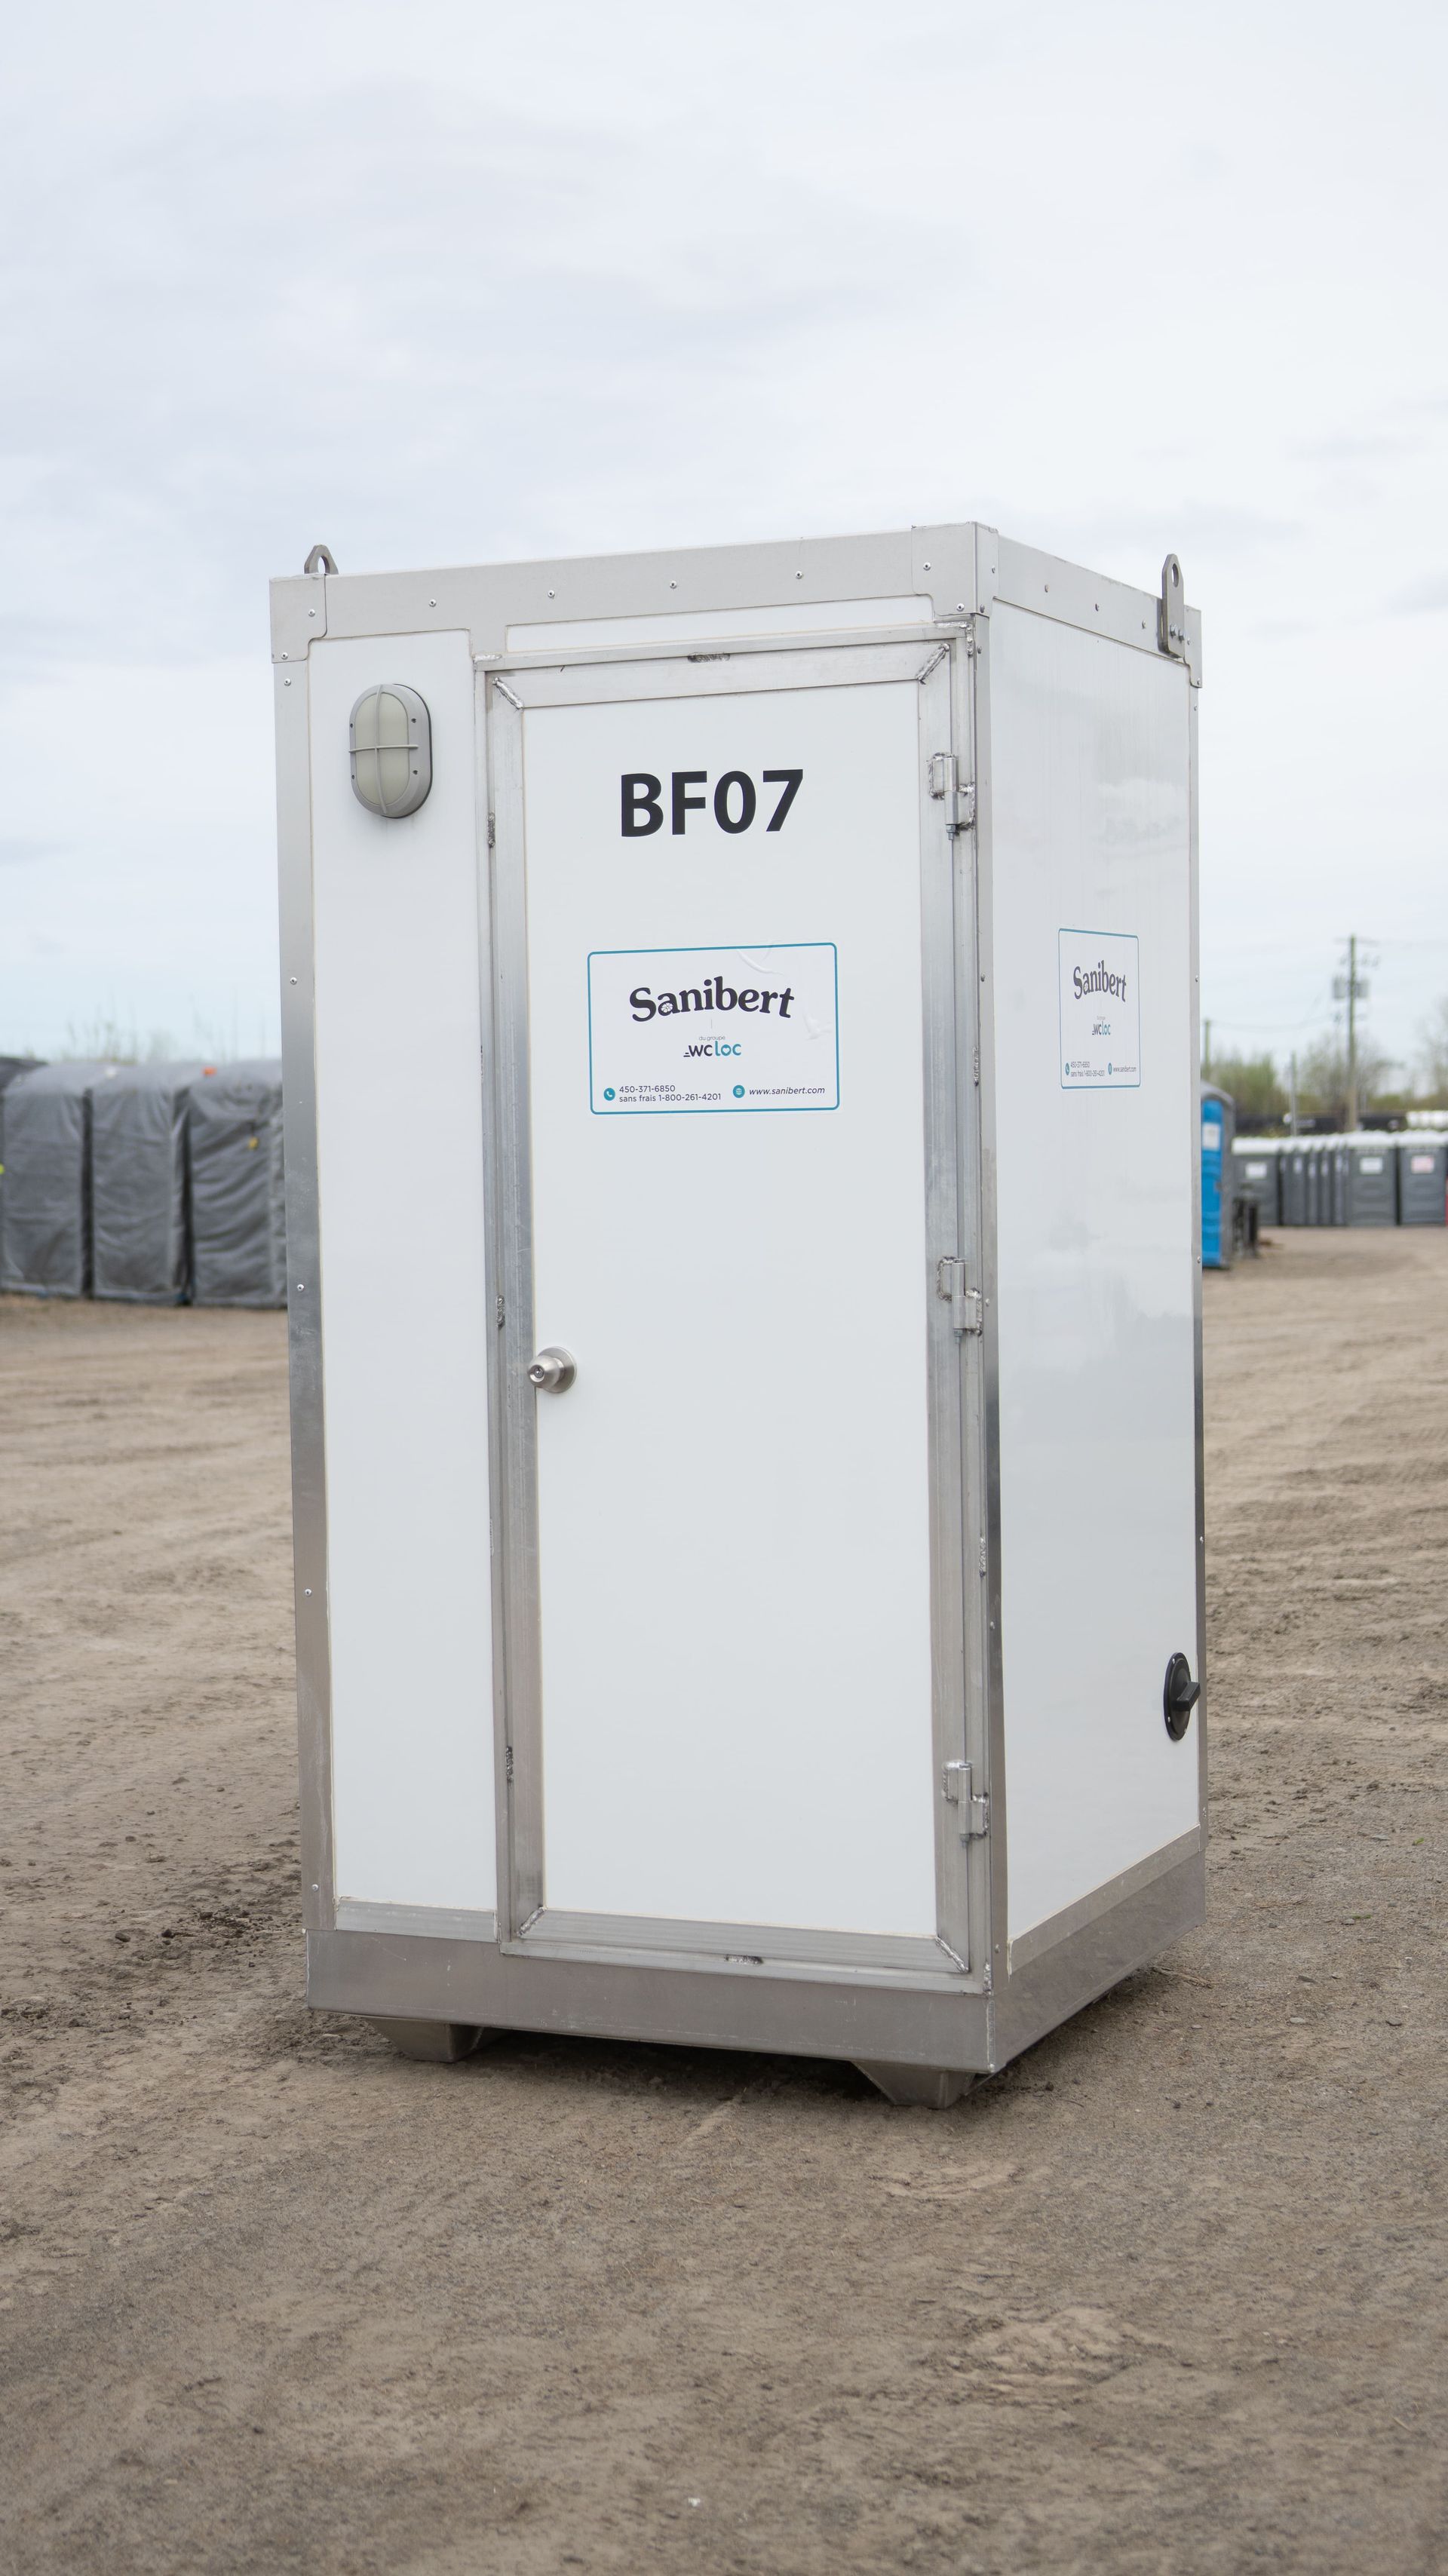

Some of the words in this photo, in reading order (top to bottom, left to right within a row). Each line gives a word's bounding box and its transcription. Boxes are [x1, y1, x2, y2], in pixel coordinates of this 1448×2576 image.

[621, 768, 803, 837] BF07
[1073, 960, 1127, 1002] Sanibert
[629, 976, 794, 1022] Sanibert
[619, 1084, 676, 1093] 450-371-6850
[640, 1094, 656, 1102] frais
[658, 1093, 721, 1102] 1-800-261-4201
[749, 1087, 825, 1095] www.sanibert.com
